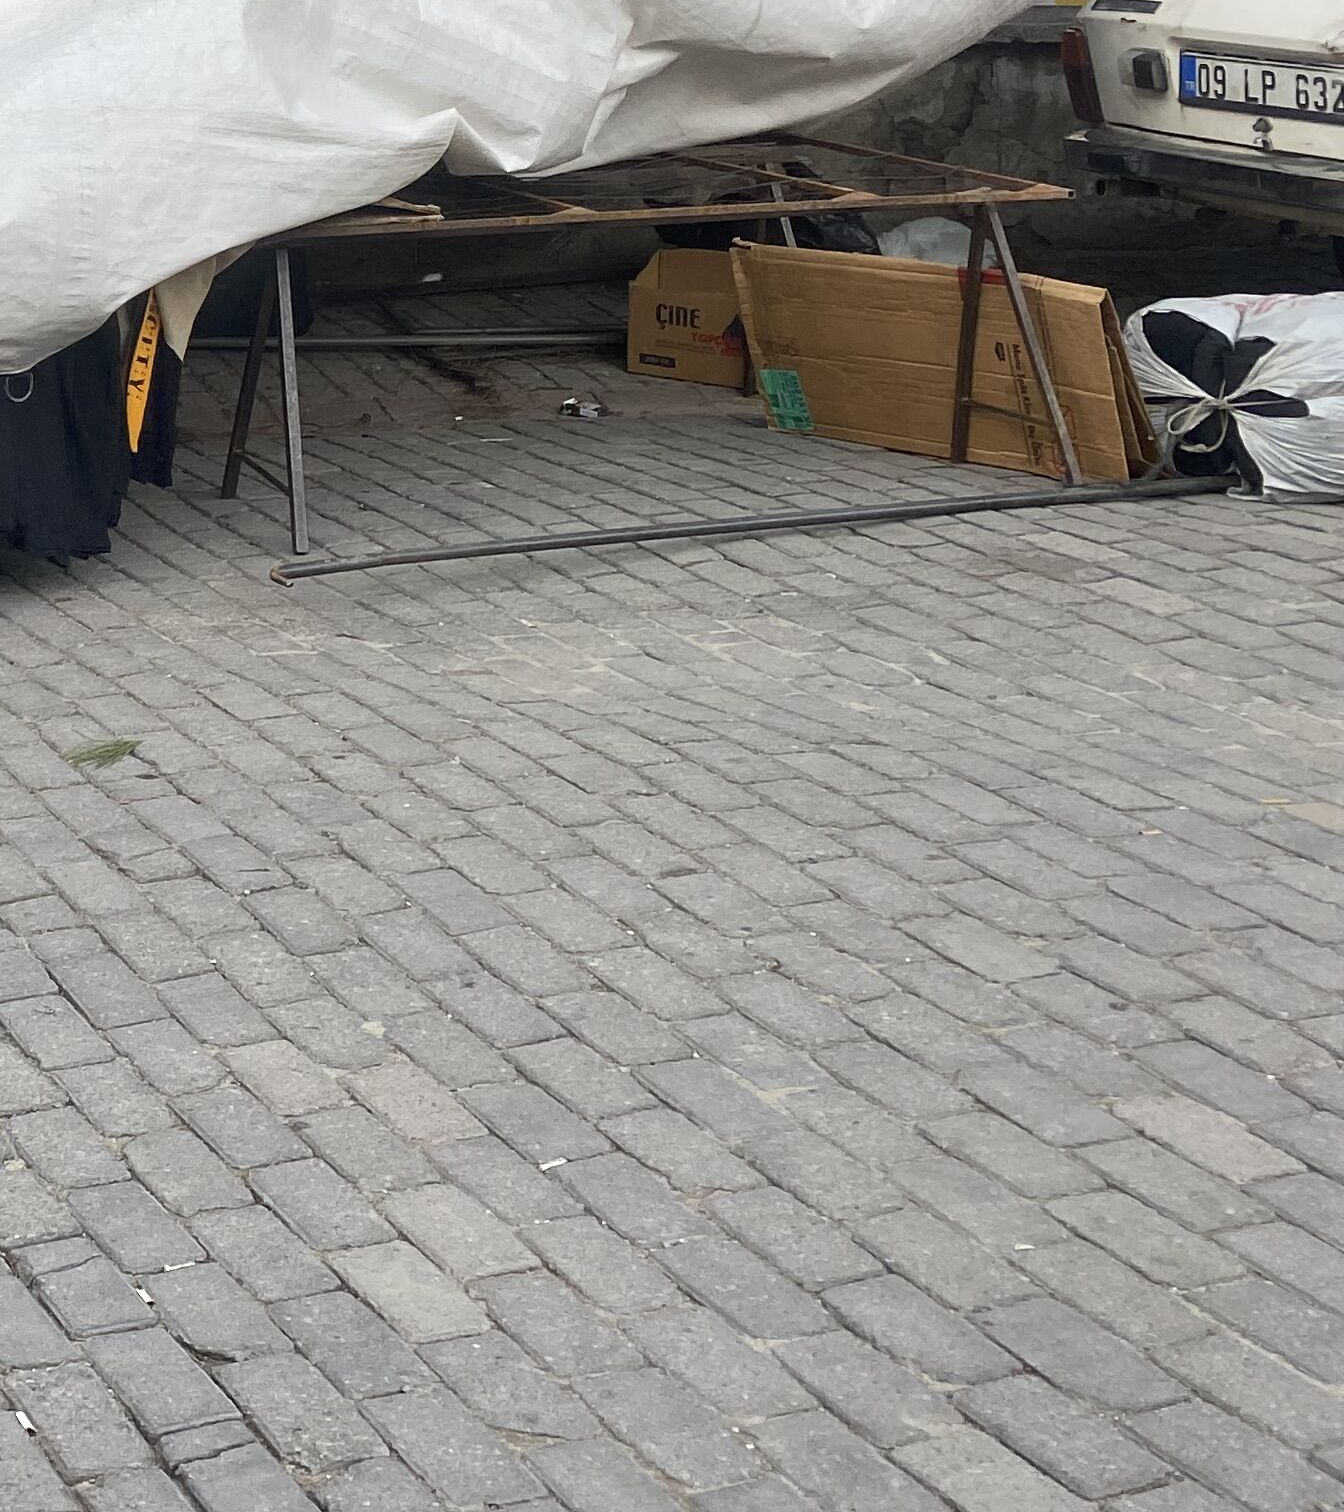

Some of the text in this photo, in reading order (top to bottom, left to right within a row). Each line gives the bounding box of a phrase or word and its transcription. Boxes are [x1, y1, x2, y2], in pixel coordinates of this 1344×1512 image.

[1198, 63, 1344, 113] 09 LP 632
